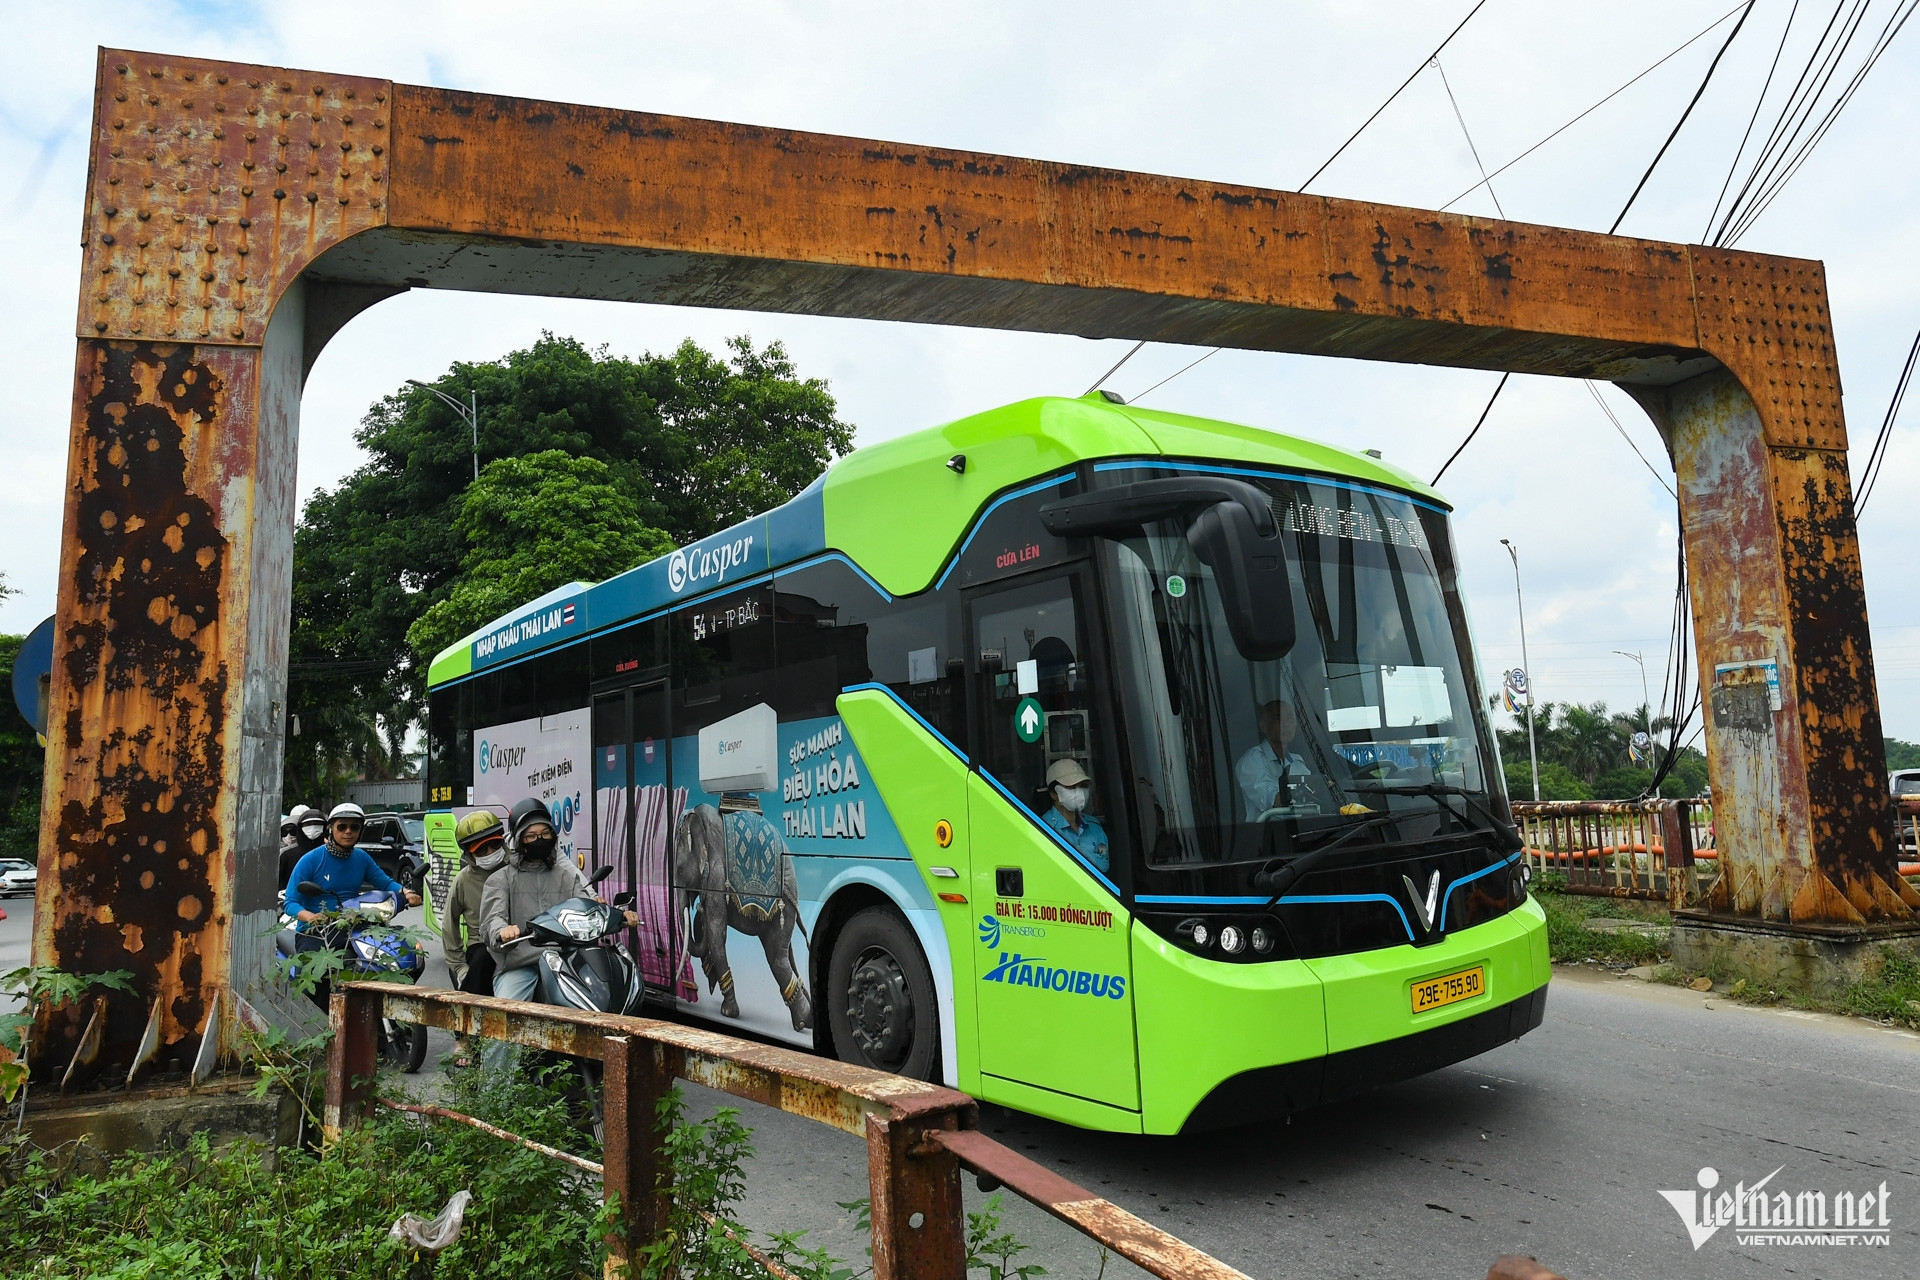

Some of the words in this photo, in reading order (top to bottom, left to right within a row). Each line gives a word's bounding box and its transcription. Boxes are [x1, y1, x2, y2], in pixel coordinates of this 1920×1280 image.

[1289, 501, 1333, 536] LONG
[1387, 517, 1404, 545] TP
[688, 535, 753, 583] Casper
[996, 547, 1017, 569] CỬA
[1019, 543, 1040, 562] LÊN
[476, 632, 497, 659] NHẬP
[520, 612, 541, 641] THÁI
[542, 607, 562, 633] LAN
[693, 613, 706, 641] 54
[725, 608, 736, 629] TP
[490, 743, 526, 776] Casper
[789, 740, 806, 765] SỨC
[807, 721, 842, 758] MẠNH
[527, 768, 540, 788] TIẾT
[557, 757, 573, 779] ĐIỆN
[783, 763, 812, 803] ĐIỀU
[815, 751, 860, 797] HÒA
[783, 800, 817, 838] THÁI
[821, 799, 868, 840] LAN
[996, 899, 1010, 917] GIÁ
[1012, 900, 1026, 919] VÉ:
[1027, 904, 1058, 922] 15.000
[1001, 923, 1047, 939] TRANSERCO
[981, 951, 1127, 1001] HANOIBUS
